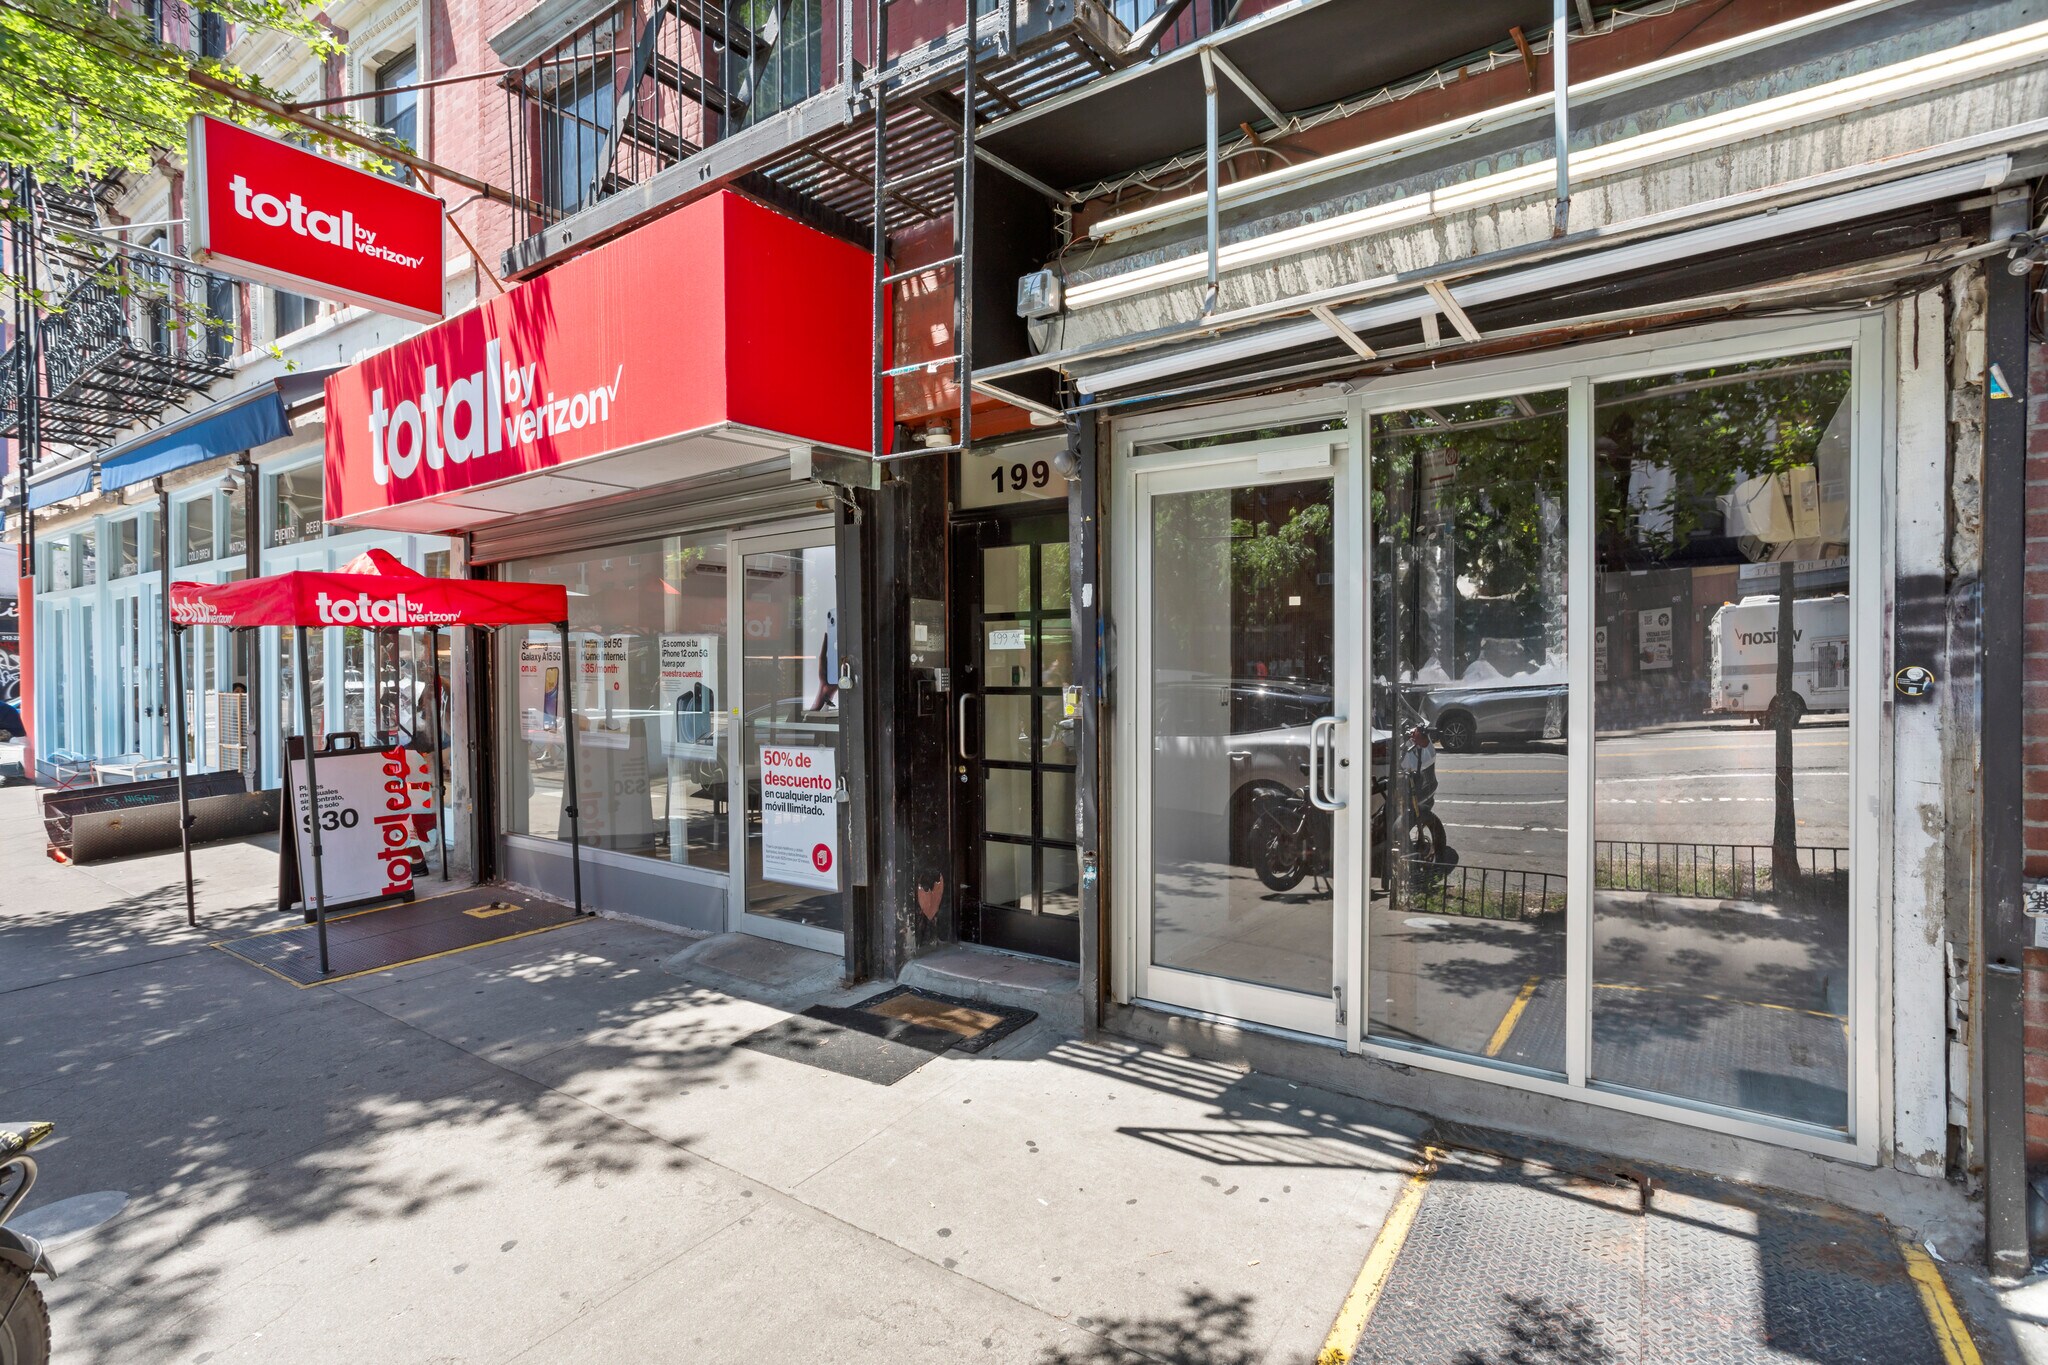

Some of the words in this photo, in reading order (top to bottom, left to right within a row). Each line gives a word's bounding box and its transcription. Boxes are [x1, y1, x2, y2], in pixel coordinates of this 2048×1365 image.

[229, 174, 353, 251] total
[355, 223, 377, 244] by
[355, 241, 417, 268] verizon
[369, 337, 502, 485] total
[504, 361, 536, 407] by
[505, 384, 608, 448] verizon
[991, 460, 1050, 493] 199
[306, 520, 321, 534] BEER
[274, 527, 296, 541] EVENTS
[188, 550, 199, 562] COLD
[315, 592, 405, 624] total
[408, 600, 423, 613] by
[408, 610, 457, 623] verizon
[612, 638, 623, 648] 5G
[686, 639, 691, 647] si
[521, 652, 541, 662] Galaxy
[542, 652, 552, 661] A15
[553, 652, 561, 661] 5G
[580, 651, 600, 661] Home
[601, 651, 626, 661] Internet
[661, 649, 680, 657] iPhone
[681, 649, 687, 657] 12
[699, 649, 708, 657] 5G
[676, 661, 685, 669] por
[661, 670, 682, 678] nuestra
[764, 751, 793, 767] 50%
[795, 752, 811, 768] de
[764, 771, 832, 790] descuento
[315, 795, 345, 804] ontrato,
[765, 790, 774, 798] en
[775, 790, 812, 803] cualquier
[814, 793, 833, 804] plan
[324, 801, 340, 809] solo
[765, 801, 786, 812] móvil
[374, 814, 414, 896] total
